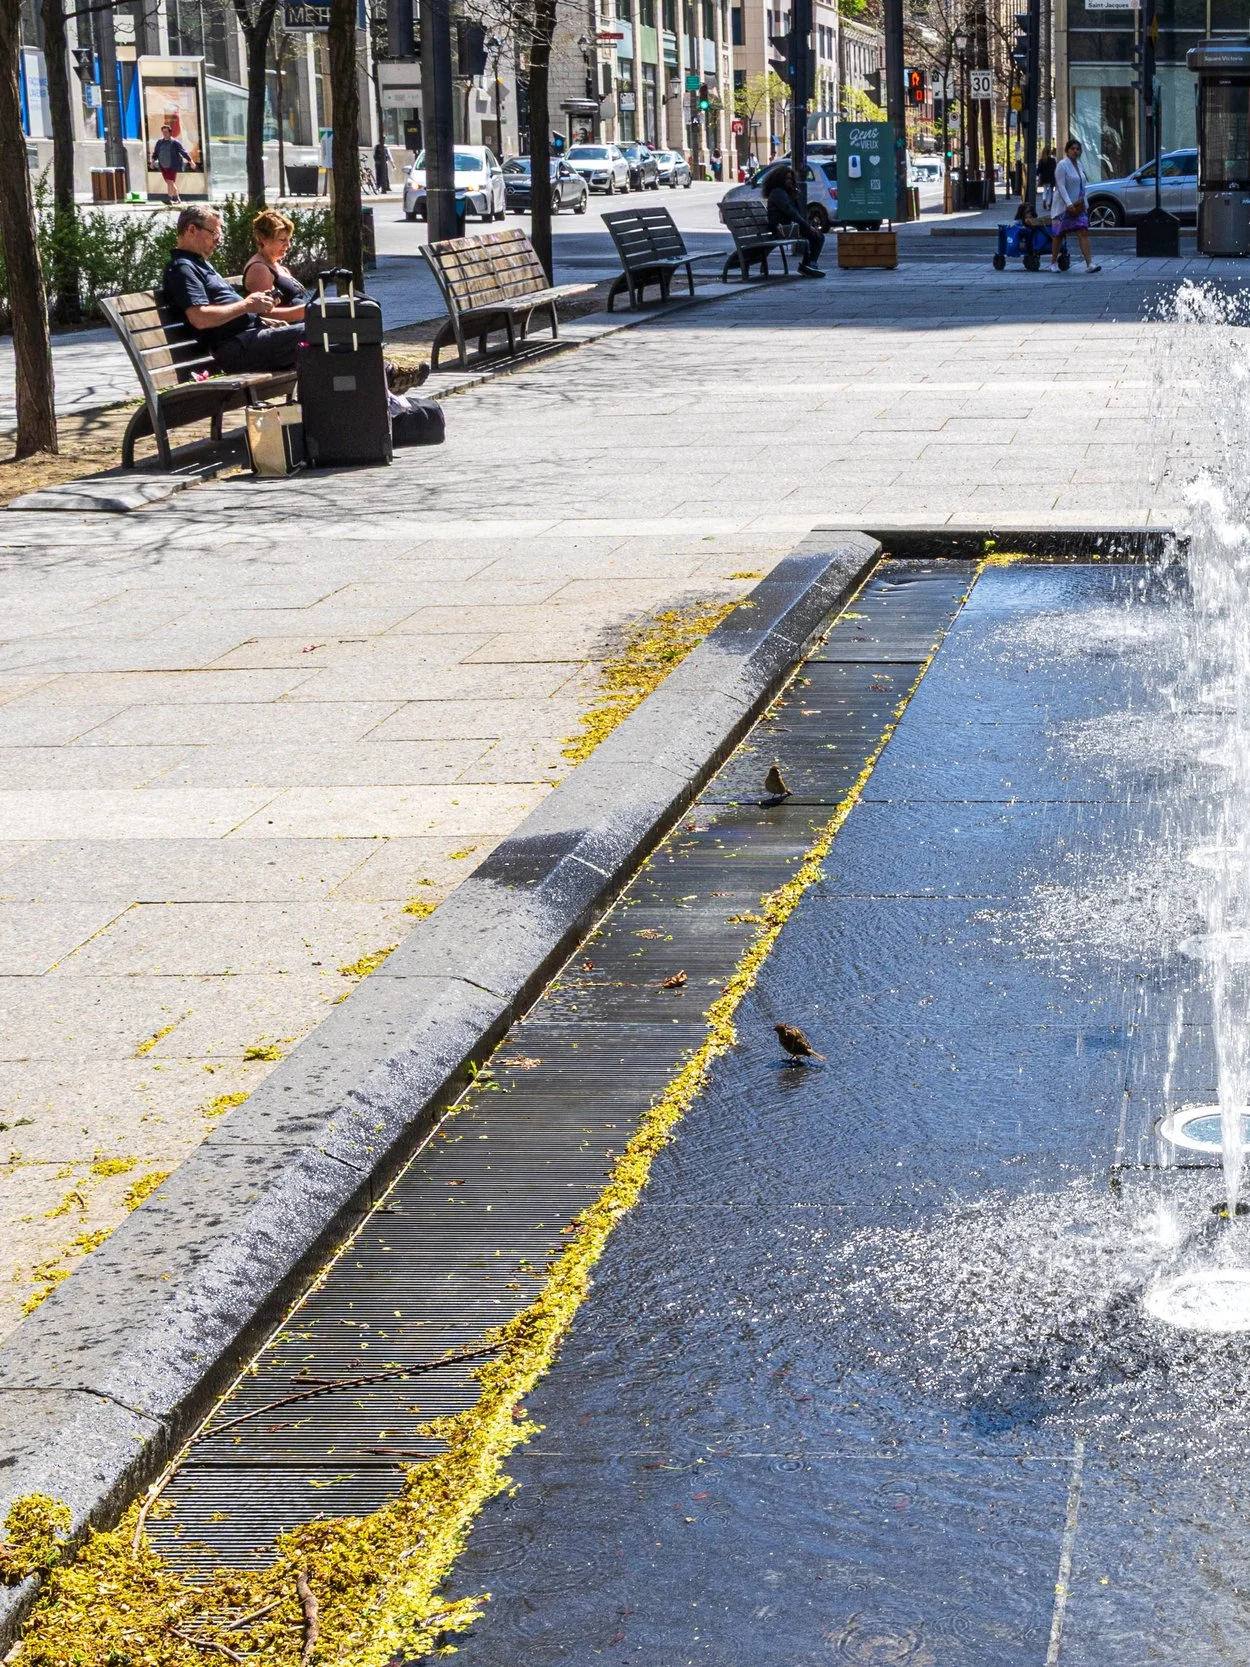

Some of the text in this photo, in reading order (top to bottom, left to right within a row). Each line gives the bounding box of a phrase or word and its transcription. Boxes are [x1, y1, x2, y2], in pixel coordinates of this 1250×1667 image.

[289, 7, 331, 23] MET
[973, 77, 990, 92] 30
[849, 128, 879, 146] Gens
[860, 140, 879, 149] VIEUX
